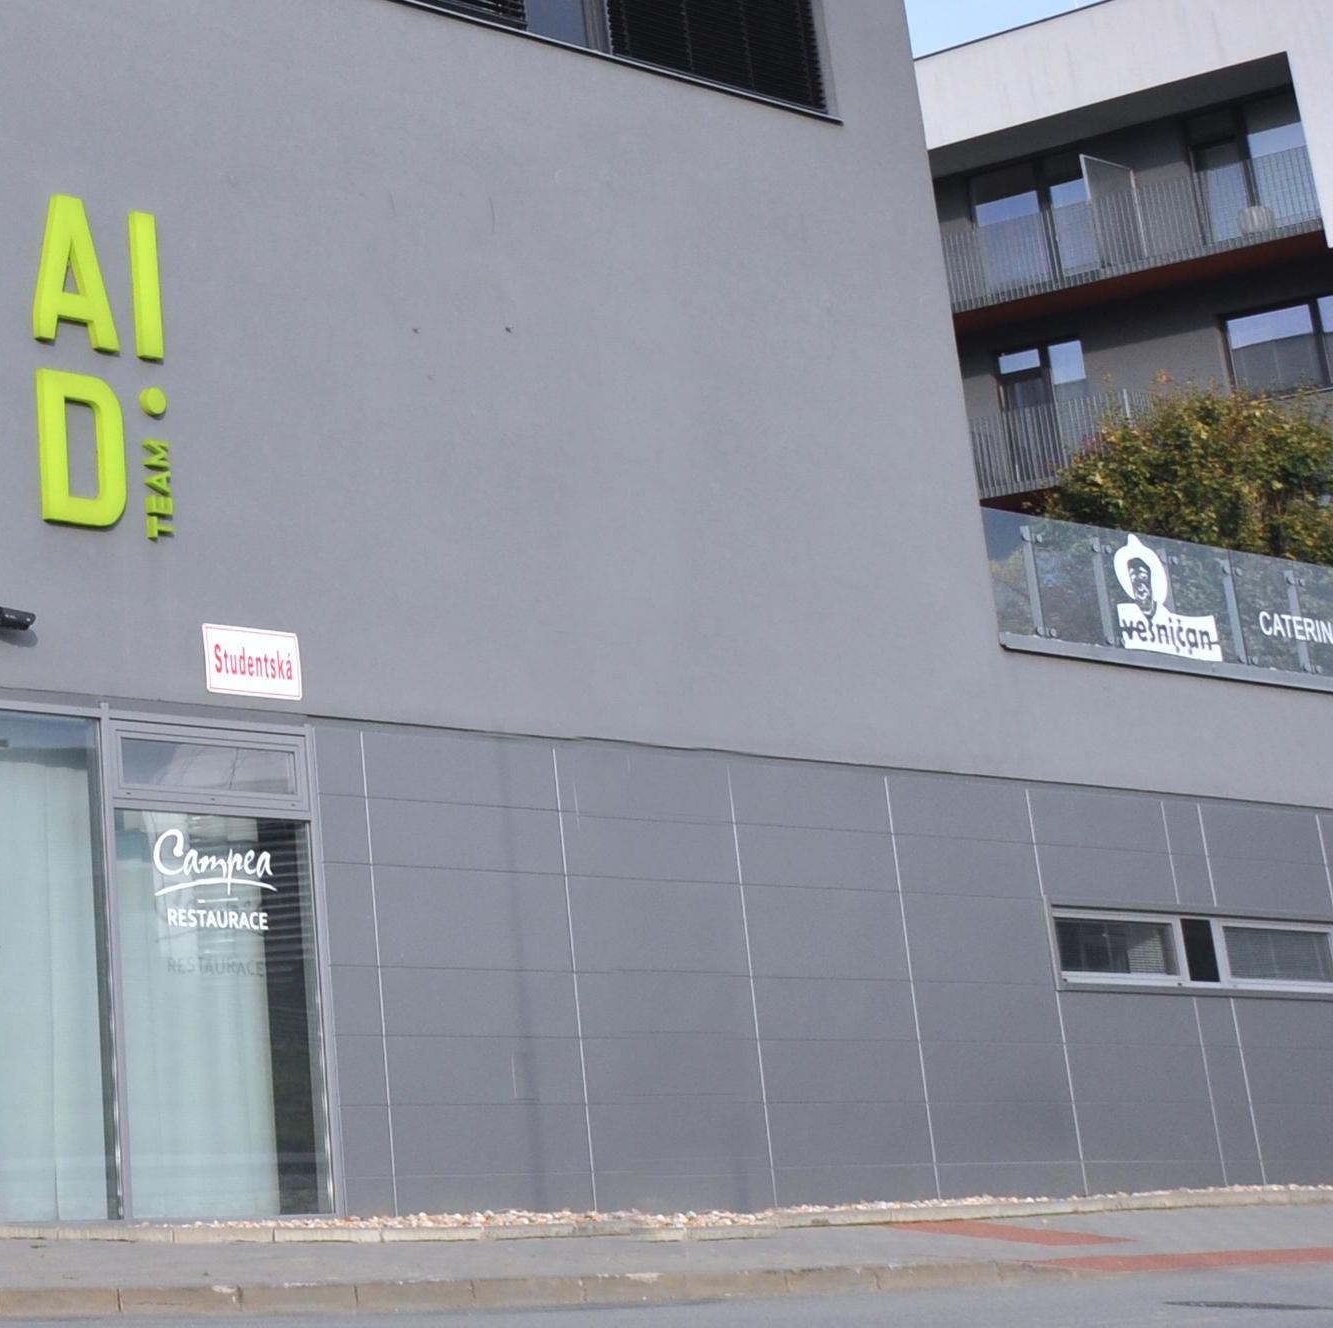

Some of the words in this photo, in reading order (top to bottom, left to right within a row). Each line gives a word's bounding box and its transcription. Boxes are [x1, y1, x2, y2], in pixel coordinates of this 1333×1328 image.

[141, 438, 175, 540] TEAM
[1258, 610, 1333, 645] CATERIN
[214, 643, 294, 682] Studentská
[153, 828, 274, 897] Campea
[167, 907, 270, 931] RESTAURACE
